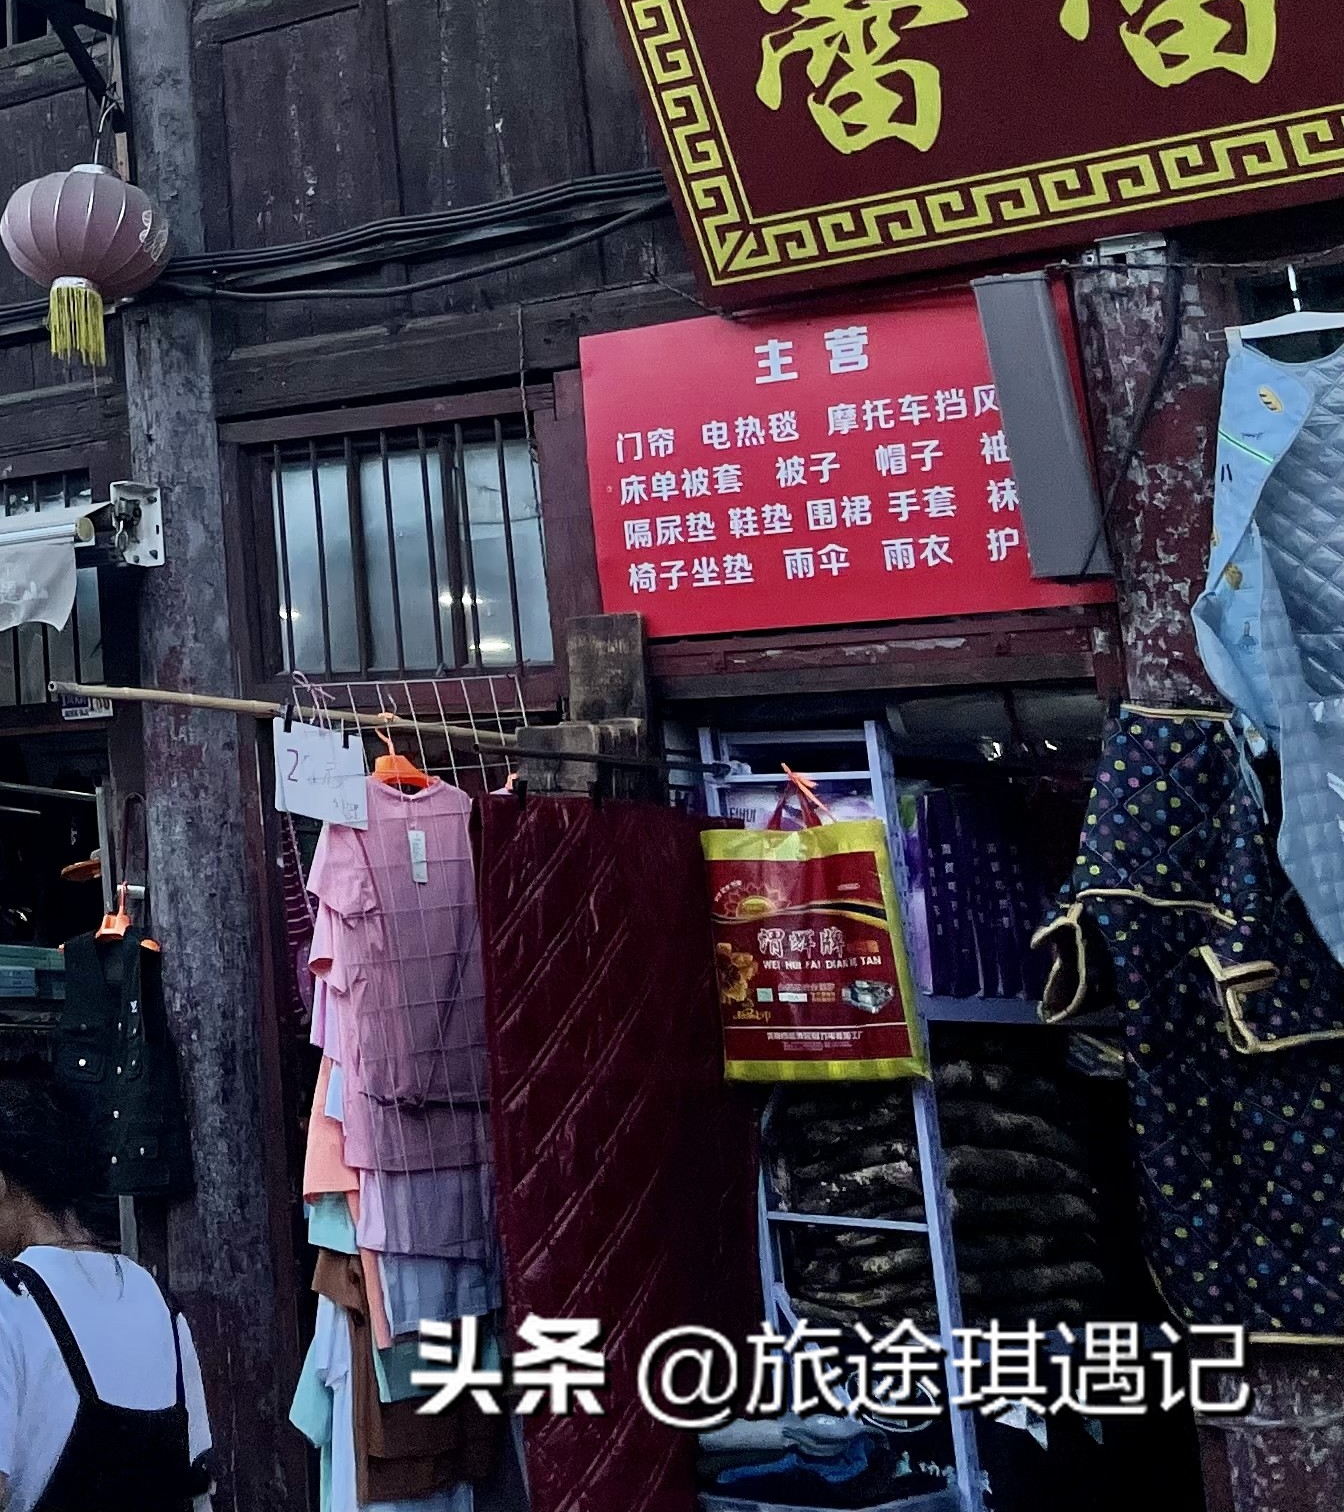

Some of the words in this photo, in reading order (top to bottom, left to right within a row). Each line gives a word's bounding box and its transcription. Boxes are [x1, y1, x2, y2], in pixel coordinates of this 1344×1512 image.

[754, 326, 869, 384] 主营
[616, 427, 675, 463] 门帘
[701, 410, 800, 450] 电热毯
[827, 384, 1000, 437] 摩托车挡风
[620, 463, 744, 506] 床单被套
[775, 451, 841, 488] 被子
[874, 439, 944, 477] 帽子
[623, 511, 717, 550] 隔尿垫
[728, 502, 794, 539] 鞋垫
[806, 494, 873, 531] 围裙
[887, 485, 958, 522] 手套
[628, 552, 755, 594] 椅子坐垫
[782, 542, 851, 580] 雨伞
[881, 534, 955, 572] 雨衣
[986, 526, 1031, 562] 护
